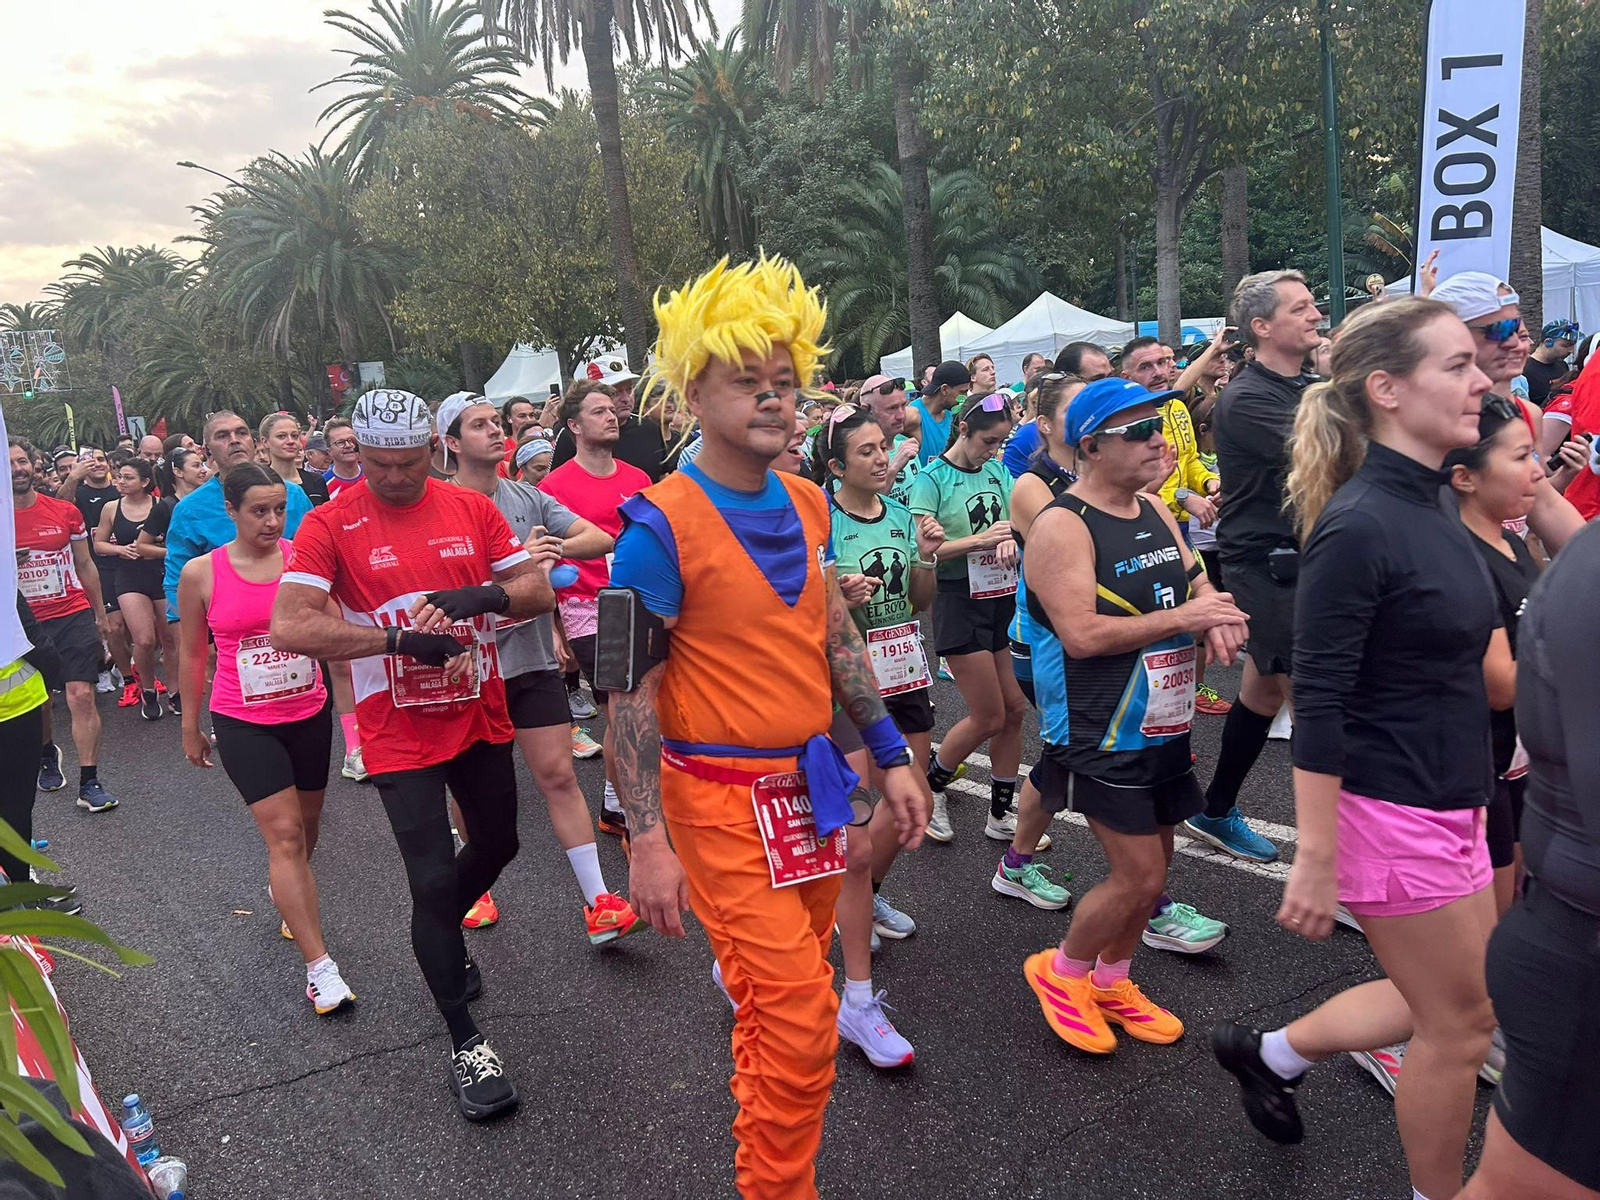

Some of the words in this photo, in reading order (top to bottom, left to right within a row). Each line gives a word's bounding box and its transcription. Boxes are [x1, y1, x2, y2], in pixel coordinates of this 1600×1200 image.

[1441, 54, 1503, 81] 1
[1430, 103, 1500, 241] BOX
[18, 568, 49, 580] 20109
[881, 641, 915, 658] 19156
[1162, 667, 1194, 690] 20030
[771, 794, 813, 819] 1140
